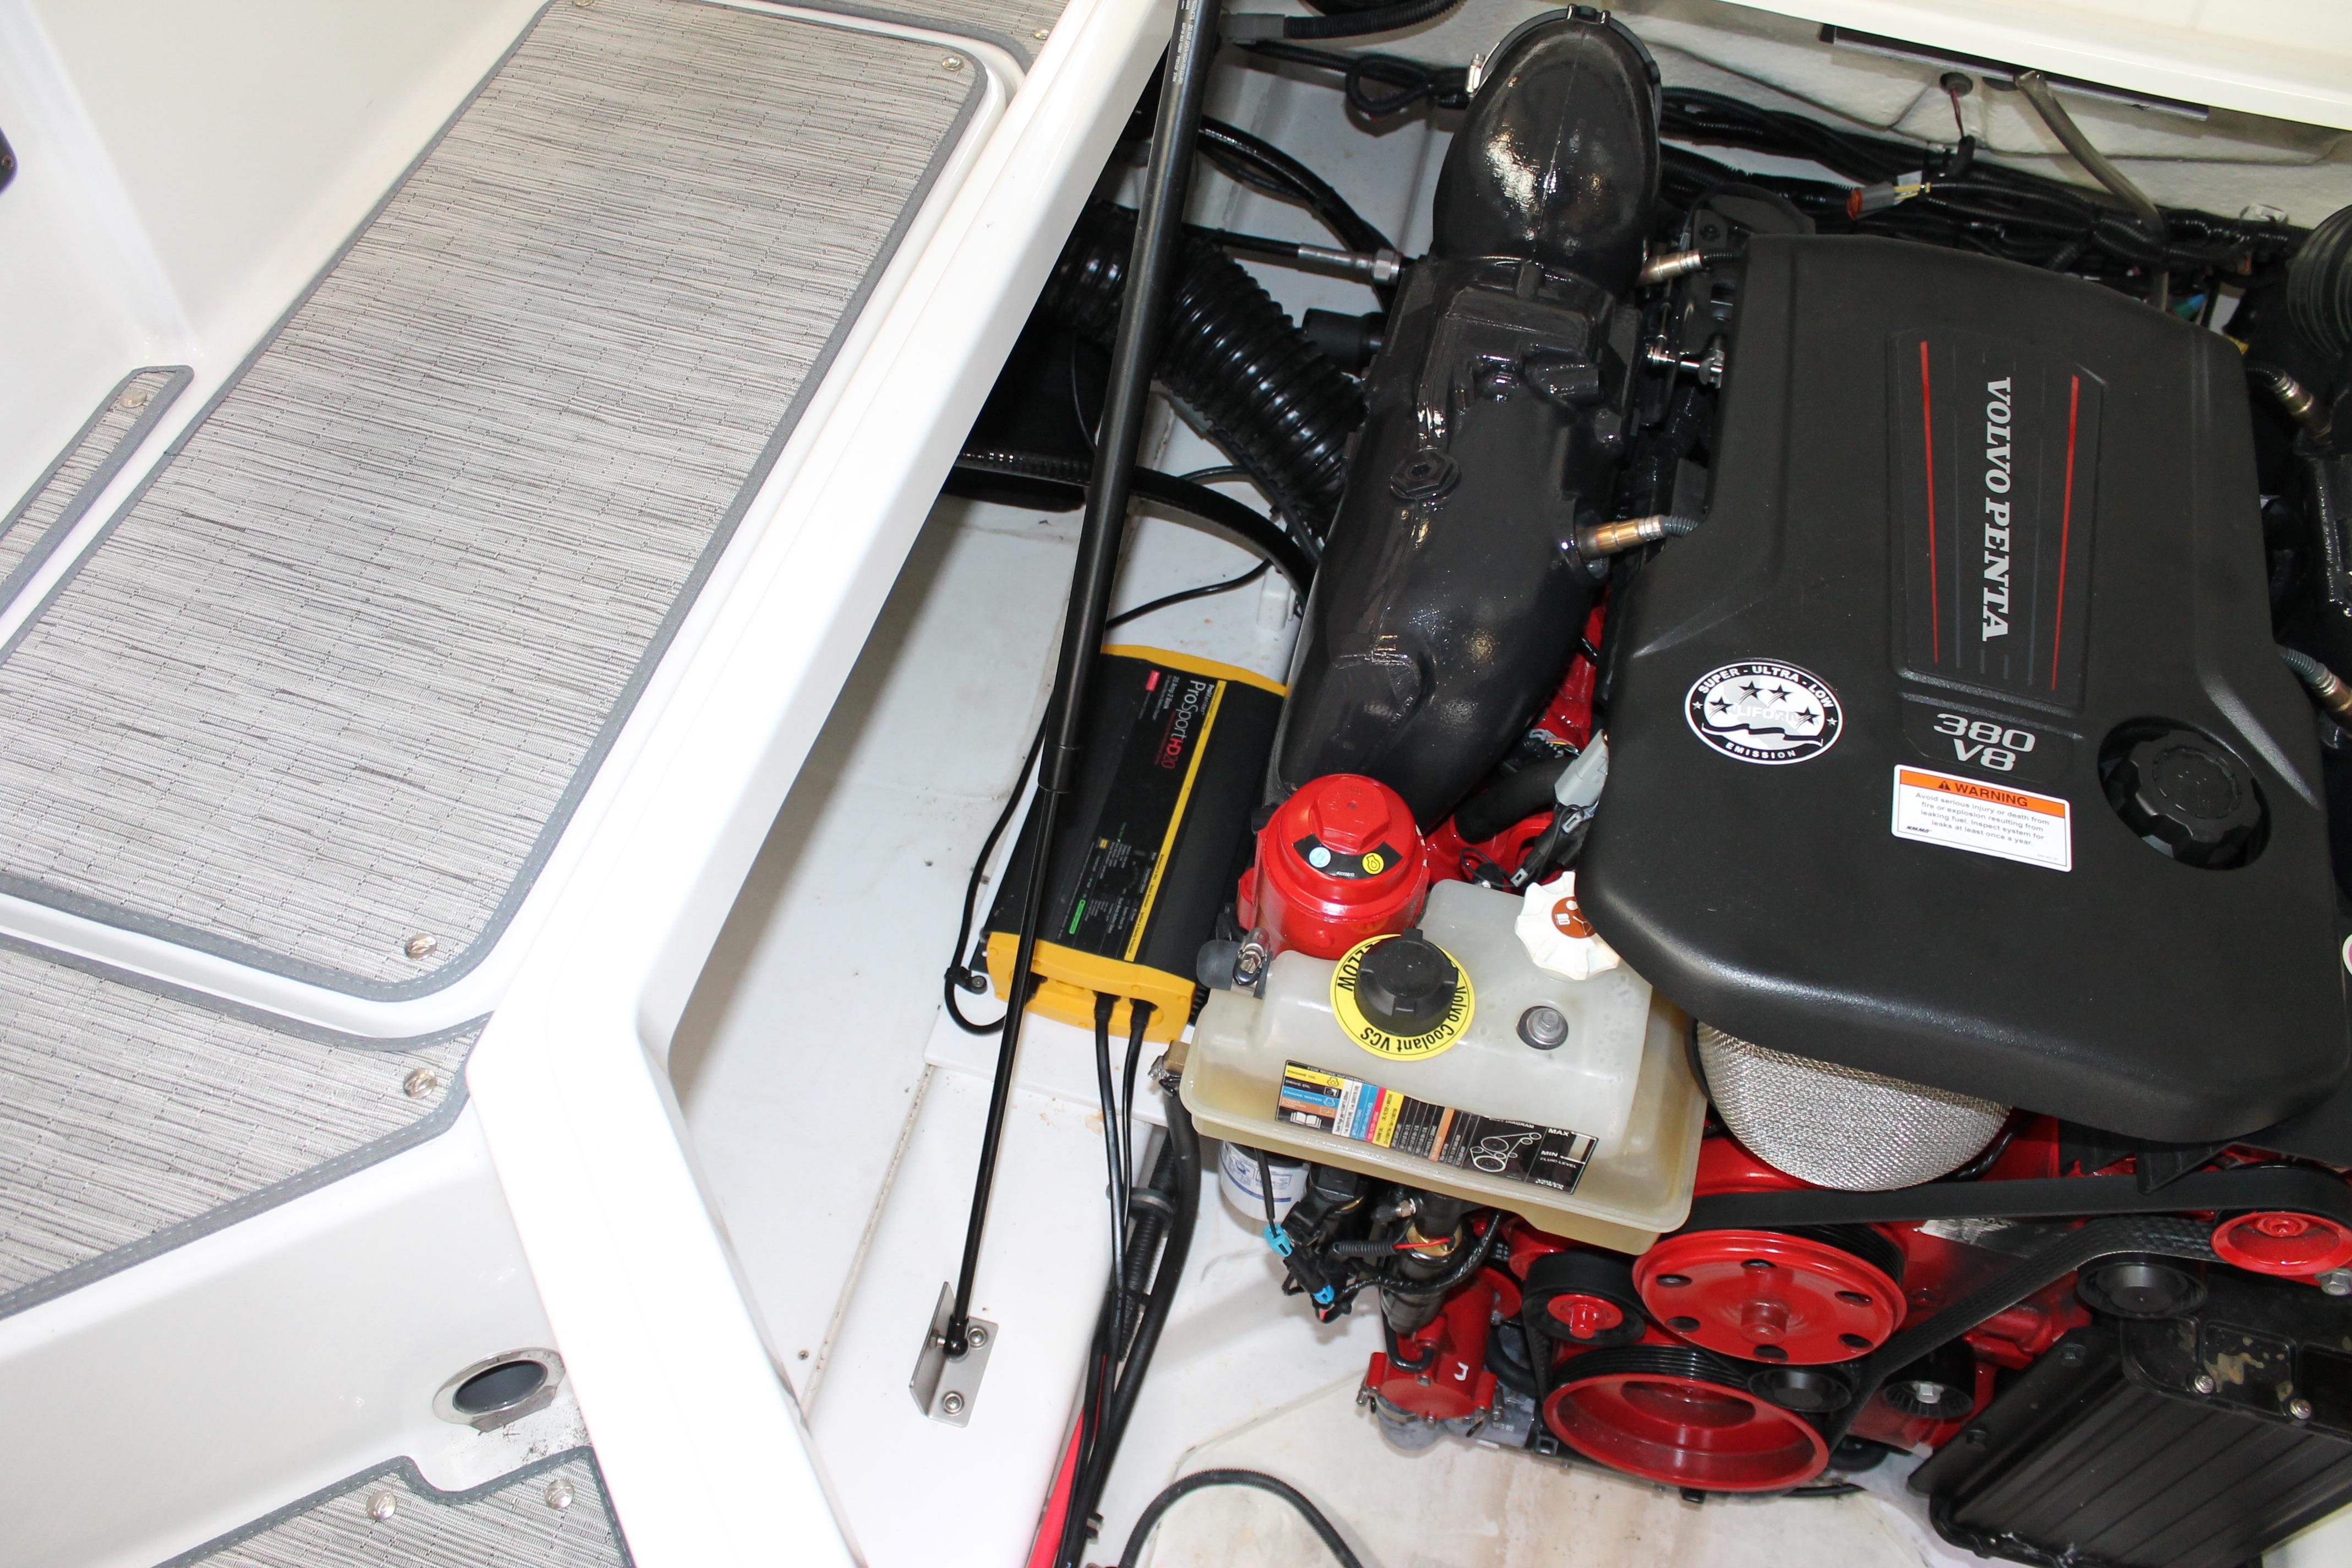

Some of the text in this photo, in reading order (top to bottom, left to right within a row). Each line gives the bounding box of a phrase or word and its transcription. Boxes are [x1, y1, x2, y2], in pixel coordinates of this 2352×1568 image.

[1982, 377, 2012, 643] VOLVO PENTA
[1698, 667, 1741, 694] SUPER
[1751, 665, 1799, 683] ULTRA
[1807, 684, 1834, 709] LOW
[1933, 712, 2036, 753] 380
[1725, 742, 1796, 759] EMISSION
[1953, 738, 2017, 772] V8
[1916, 792, 1939, 802] Avoid
[1940, 798, 1970, 808] serious
[1972, 803, 1995, 814] injury
[2007, 811, 2029, 821] death
[2031, 815, 2050, 825] from
[1954, 782, 2028, 807] WARNING
[1920, 809, 1950, 821] leaking
[1951, 815, 1969, 825] fuel.
[1971, 819, 2000, 832] Inspect
[2002, 827, 2031, 838] system
[1931, 820, 1952, 829] leaks
[1964, 826, 1984, 836] least
[1985, 831, 2006, 840] once
[2014, 837, 2033, 847] year.
[1947, 808, 1986, 819] explosion
[1988, 814, 2023, 828] resulting
[2024, 822, 2044, 832] from
[1360, 986, 1468, 1053] Volvo Coolant VCS
[1287, 1069, 1307, 1079] ENGINE
[1548, 1128, 1570, 1137] MAX
[1558, 1161, 1577, 1169] LEVEL
